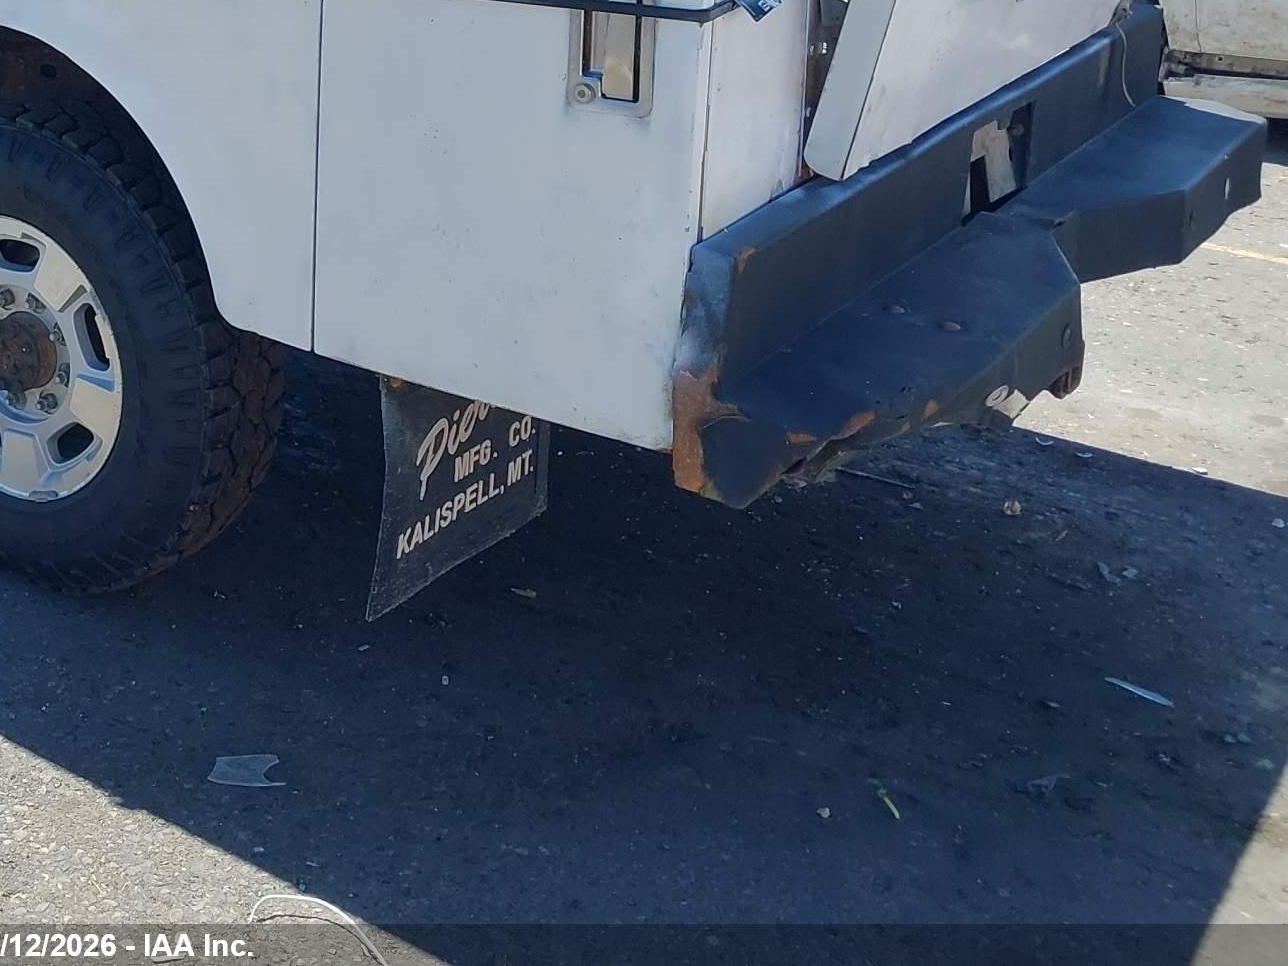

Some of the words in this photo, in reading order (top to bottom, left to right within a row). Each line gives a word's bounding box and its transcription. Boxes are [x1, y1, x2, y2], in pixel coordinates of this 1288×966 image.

[454, 439, 498, 482] MFG.
[509, 415, 537, 447] CO.
[396, 472, 505, 560] KALISPELL,
[507, 449, 535, 486] MT.
